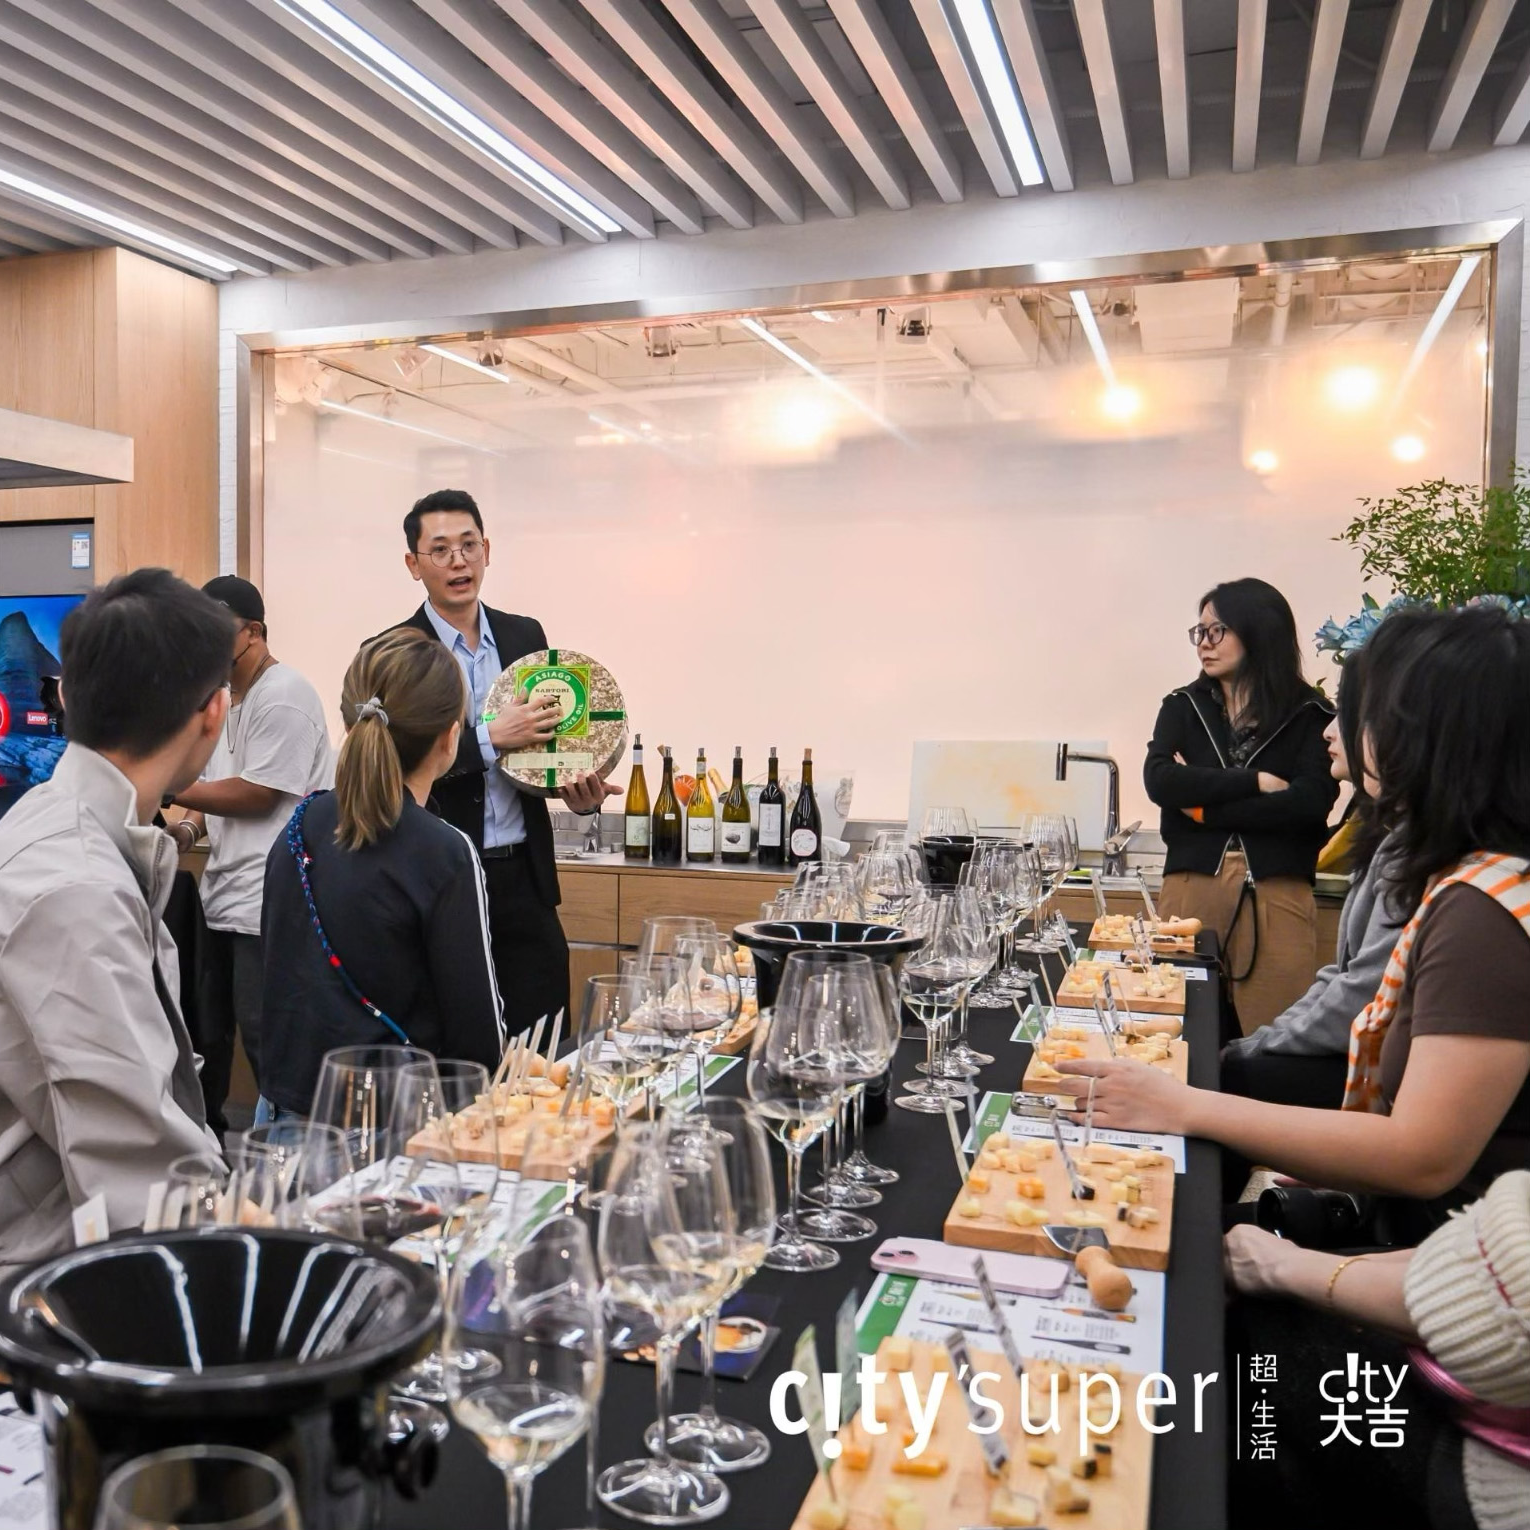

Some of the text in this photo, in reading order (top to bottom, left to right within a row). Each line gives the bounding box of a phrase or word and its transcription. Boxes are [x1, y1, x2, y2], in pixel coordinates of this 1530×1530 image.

[534, 670, 572, 682] ASIAGO
[28, 714, 47, 723] Lenovo
[556, 703, 585, 732] OLIVE OIL
